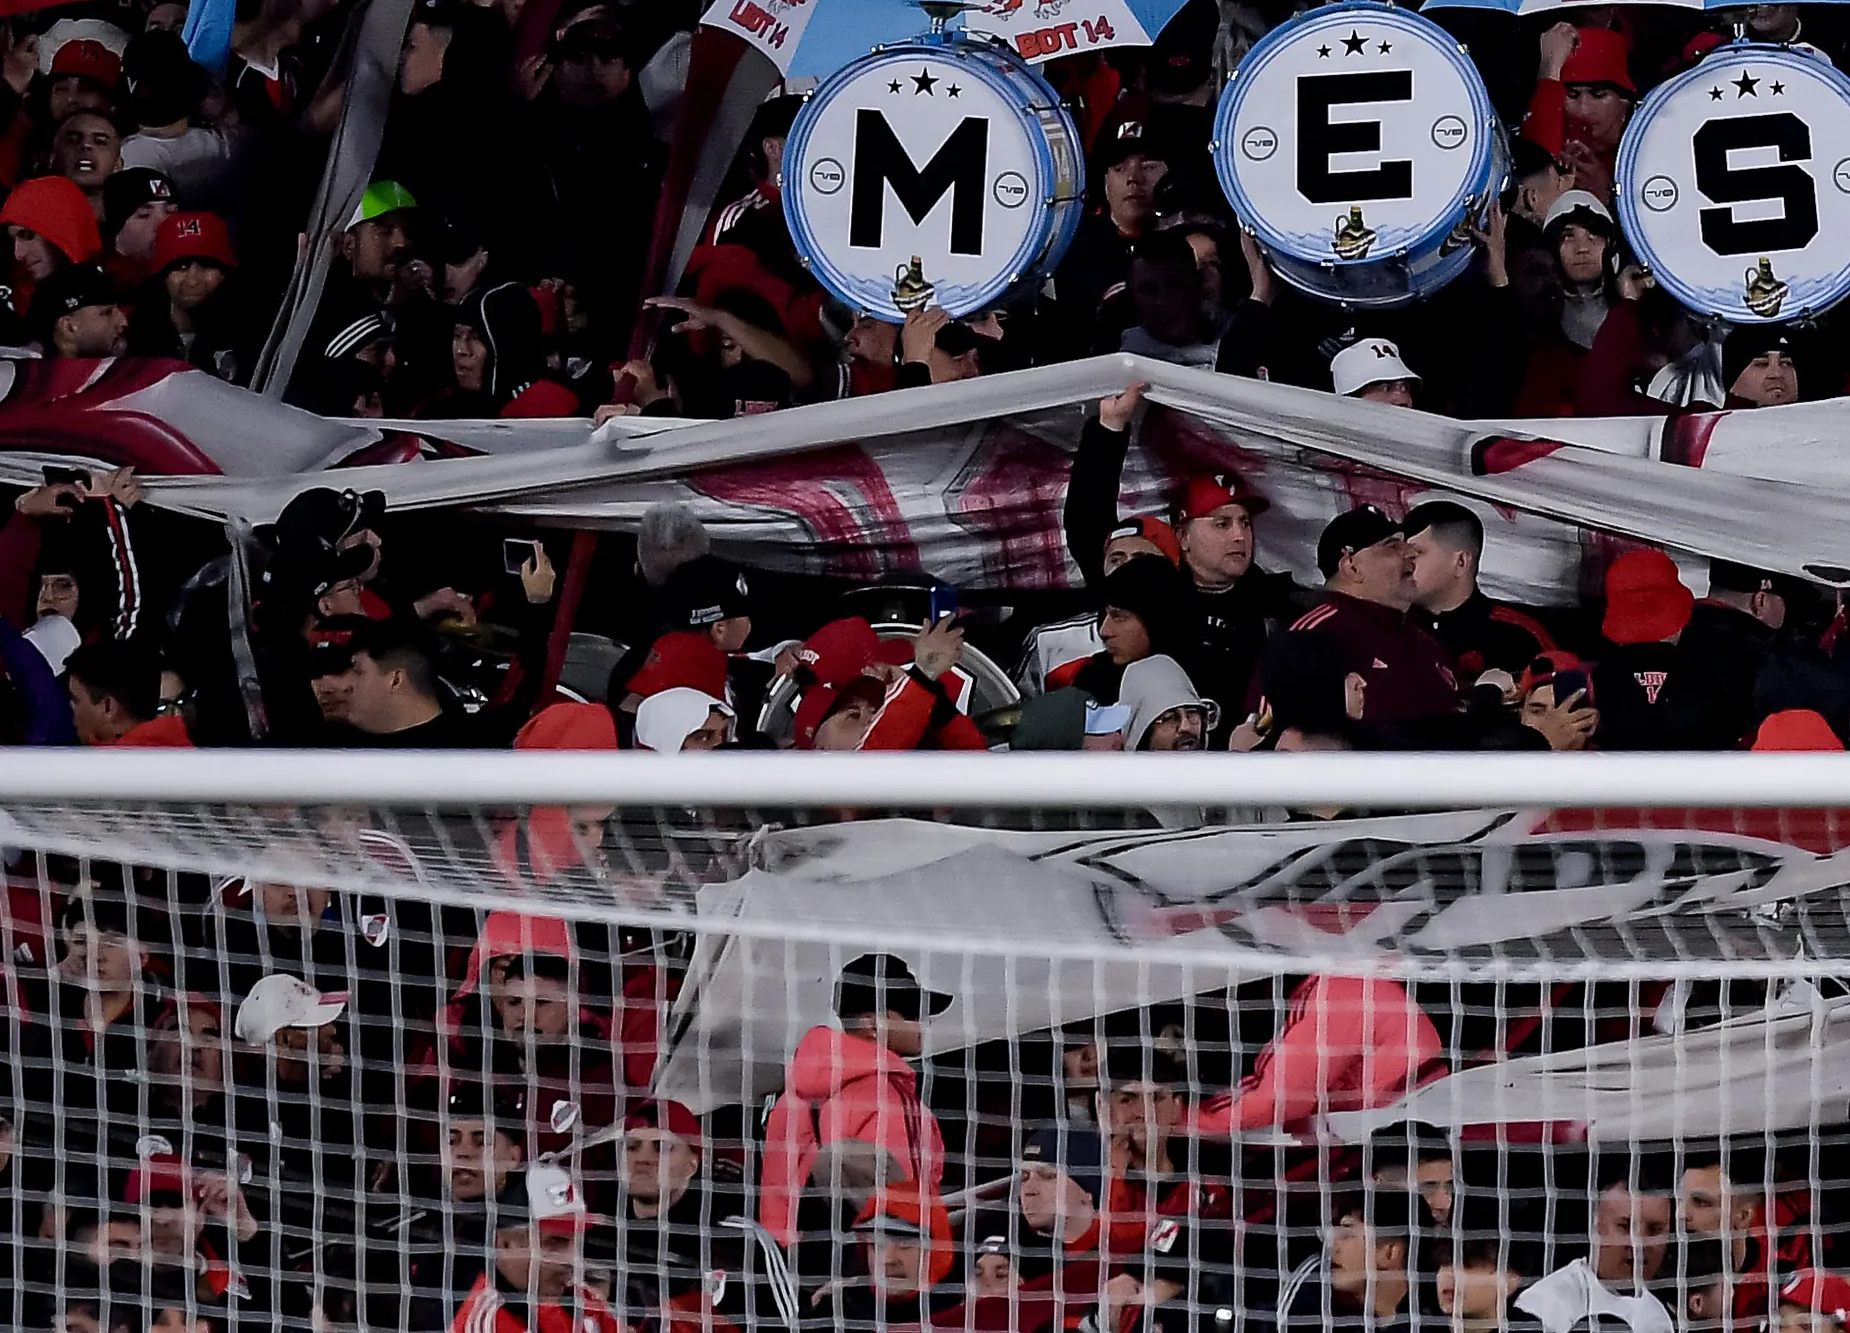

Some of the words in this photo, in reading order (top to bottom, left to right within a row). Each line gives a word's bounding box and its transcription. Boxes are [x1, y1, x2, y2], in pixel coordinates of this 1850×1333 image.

[768, 22, 790, 49] 14
[1015, 22, 1080, 61] BDT
[1081, 15, 1117, 44] 14
[850, 109, 988, 255] M
[1297, 71, 1412, 203] E
[1693, 113, 1818, 255] S
[176, 218, 202, 238] 14
